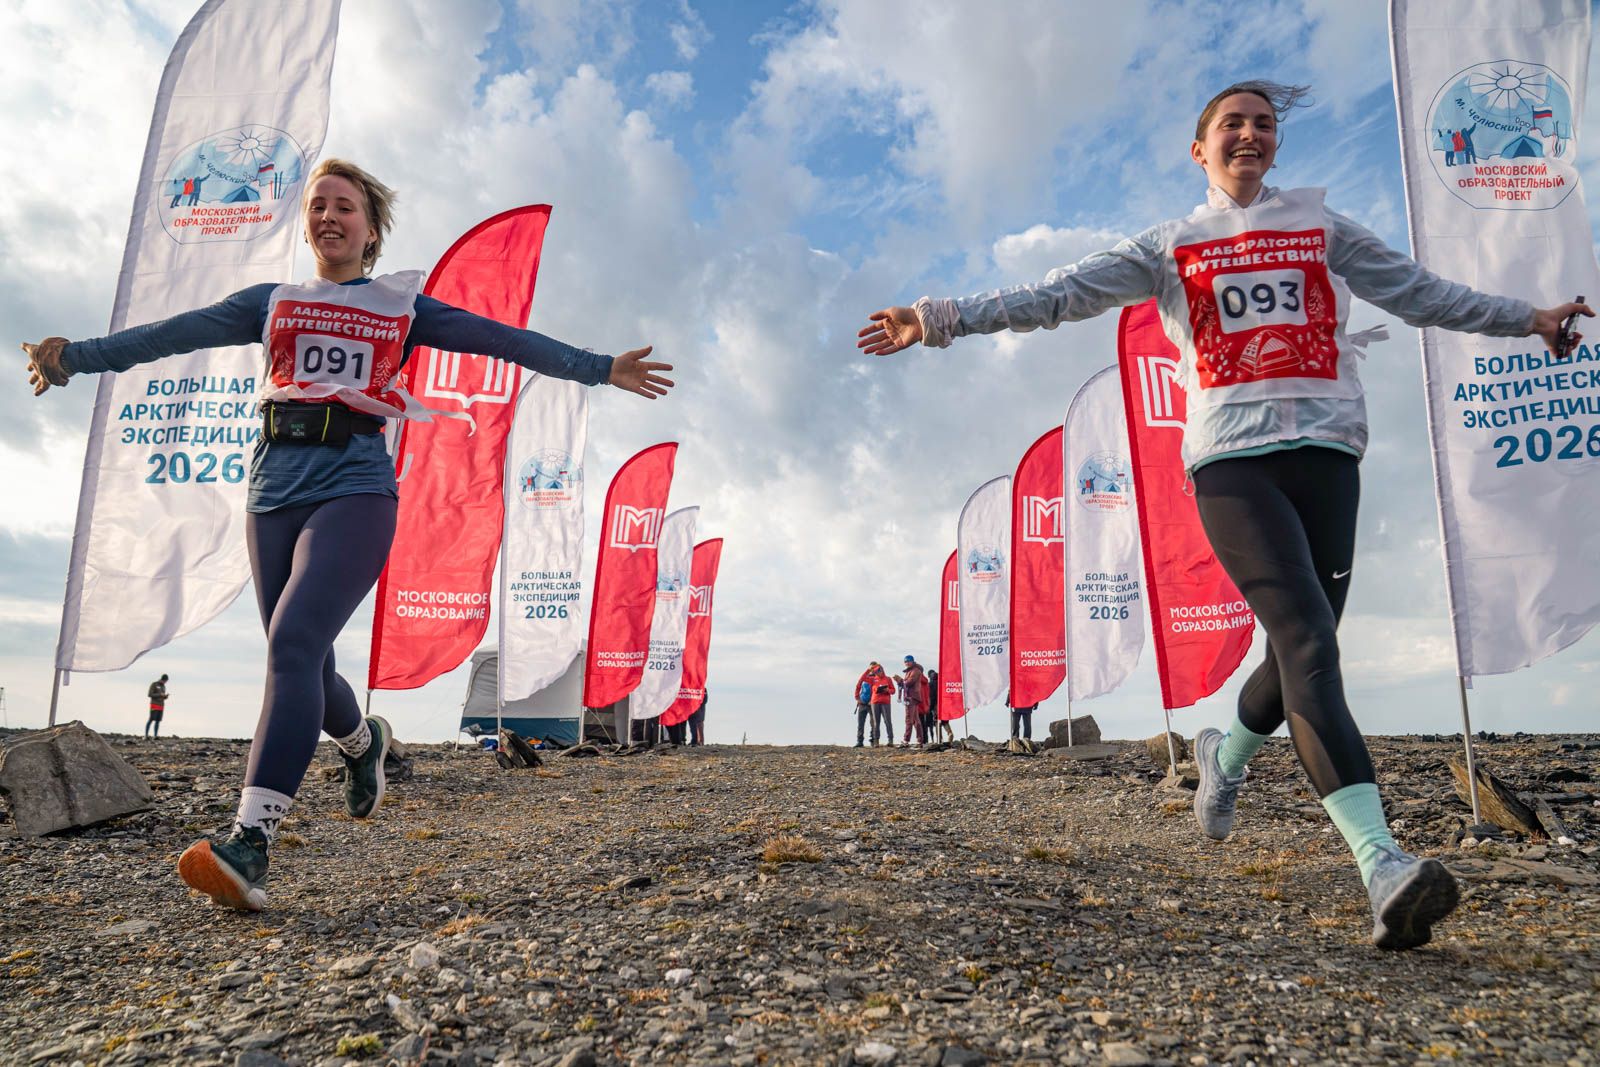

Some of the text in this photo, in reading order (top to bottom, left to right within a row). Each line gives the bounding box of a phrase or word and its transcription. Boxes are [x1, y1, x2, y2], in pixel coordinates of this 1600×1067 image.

[1468, 109, 1522, 132] Челюскин
[1475, 163, 1547, 176] МОСКОВСКИЙ
[1458, 175, 1565, 188] ОБРАЗОВАТЕЛЬНЫЙ
[1495, 190, 1531, 201] ПРОЕКТ
[191, 205, 261, 216] МОСКОВСКИЙ
[174, 213, 273, 227] ОБРАЗОВАТЕЛЬНЫЙ
[201, 226, 240, 236] ПРОЕКТ
[1201, 236, 1322, 257] ЛАБОРАТОРИЯ
[1185, 247, 1326, 277] ПУТЕШЕСТВИЙ
[1222, 281, 1300, 318] 093
[293, 306, 398, 328] ЛАБОРАТОРИЯ
[275, 317, 400, 342] ПУТЕШЕСТВИЙ
[303, 345, 364, 380] 091
[146, 376, 255, 396] БОЛЬШАЯ
[1454, 370, 1600, 402] АРКТИЧЕСК
[118, 401, 263, 420] АРКТИЧЕСКА
[1463, 397, 1600, 428] ЭКСПЕДИЦ
[121, 426, 261, 447] ЭКСПЕДИЦИ
[145, 451, 245, 483] 2026
[521, 571, 572, 580] БОЛЬШАЯ
[1085, 573, 1129, 582] БОЛЬШАЯ
[510, 582, 581, 591] АРКТИЧЕСКАЯ
[1075, 582, 1139, 592] АРКТИЧЕСКАЯ
[397, 590, 488, 605] МОСКОВСКОЕ
[513, 592, 580, 603] ЭКСПЕДИЦИЯ
[1078, 592, 1140, 604] ЭКСПЕДИЦИЯ
[396, 605, 486, 620] ОБРАЗОВАНИЕ
[525, 604, 568, 619] 2026
[1090, 606, 1130, 620] 2026
[1172, 613, 1253, 633] ОБРАЗОВАНИЕ
[969, 637, 1009, 645] ЭКСПЕДИЦИ
[977, 645, 1003, 656] 2026
[1020, 649, 1066, 658] МОСКОВСКО
[649, 661, 676, 671] 2026
[1020, 658, 1066, 667] ОБРАЗОВАНИ
